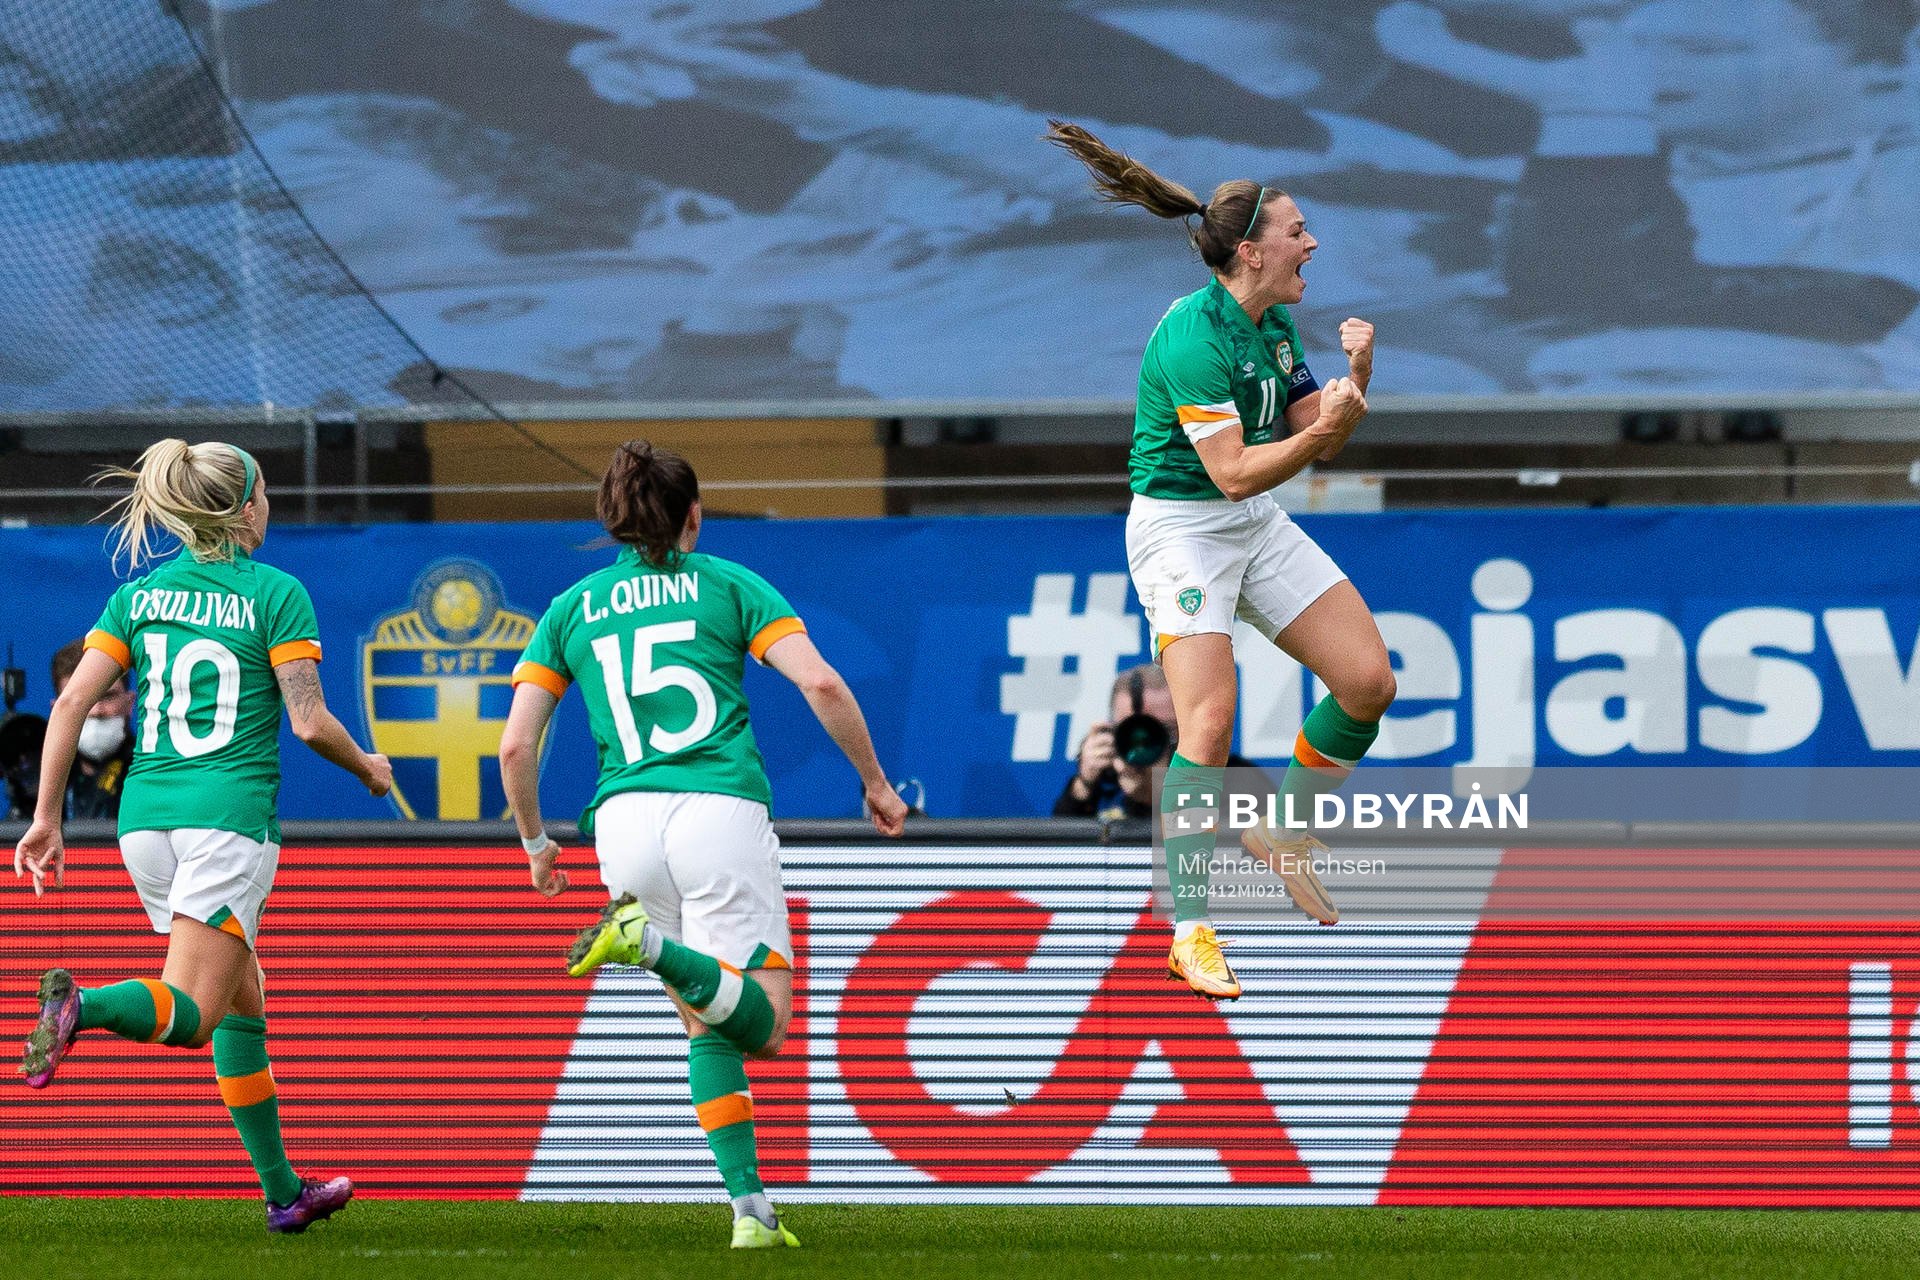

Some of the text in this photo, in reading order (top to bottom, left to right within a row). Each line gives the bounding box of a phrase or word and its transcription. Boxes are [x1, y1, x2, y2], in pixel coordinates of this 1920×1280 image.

[1258, 377, 1276, 429] 11
[130, 588, 256, 632] O'SULLIVAN
[583, 571, 700, 624] L.QUINN
[422, 651, 496, 674] SvFF
[141, 632, 241, 758] 10
[591, 620, 718, 765] 15
